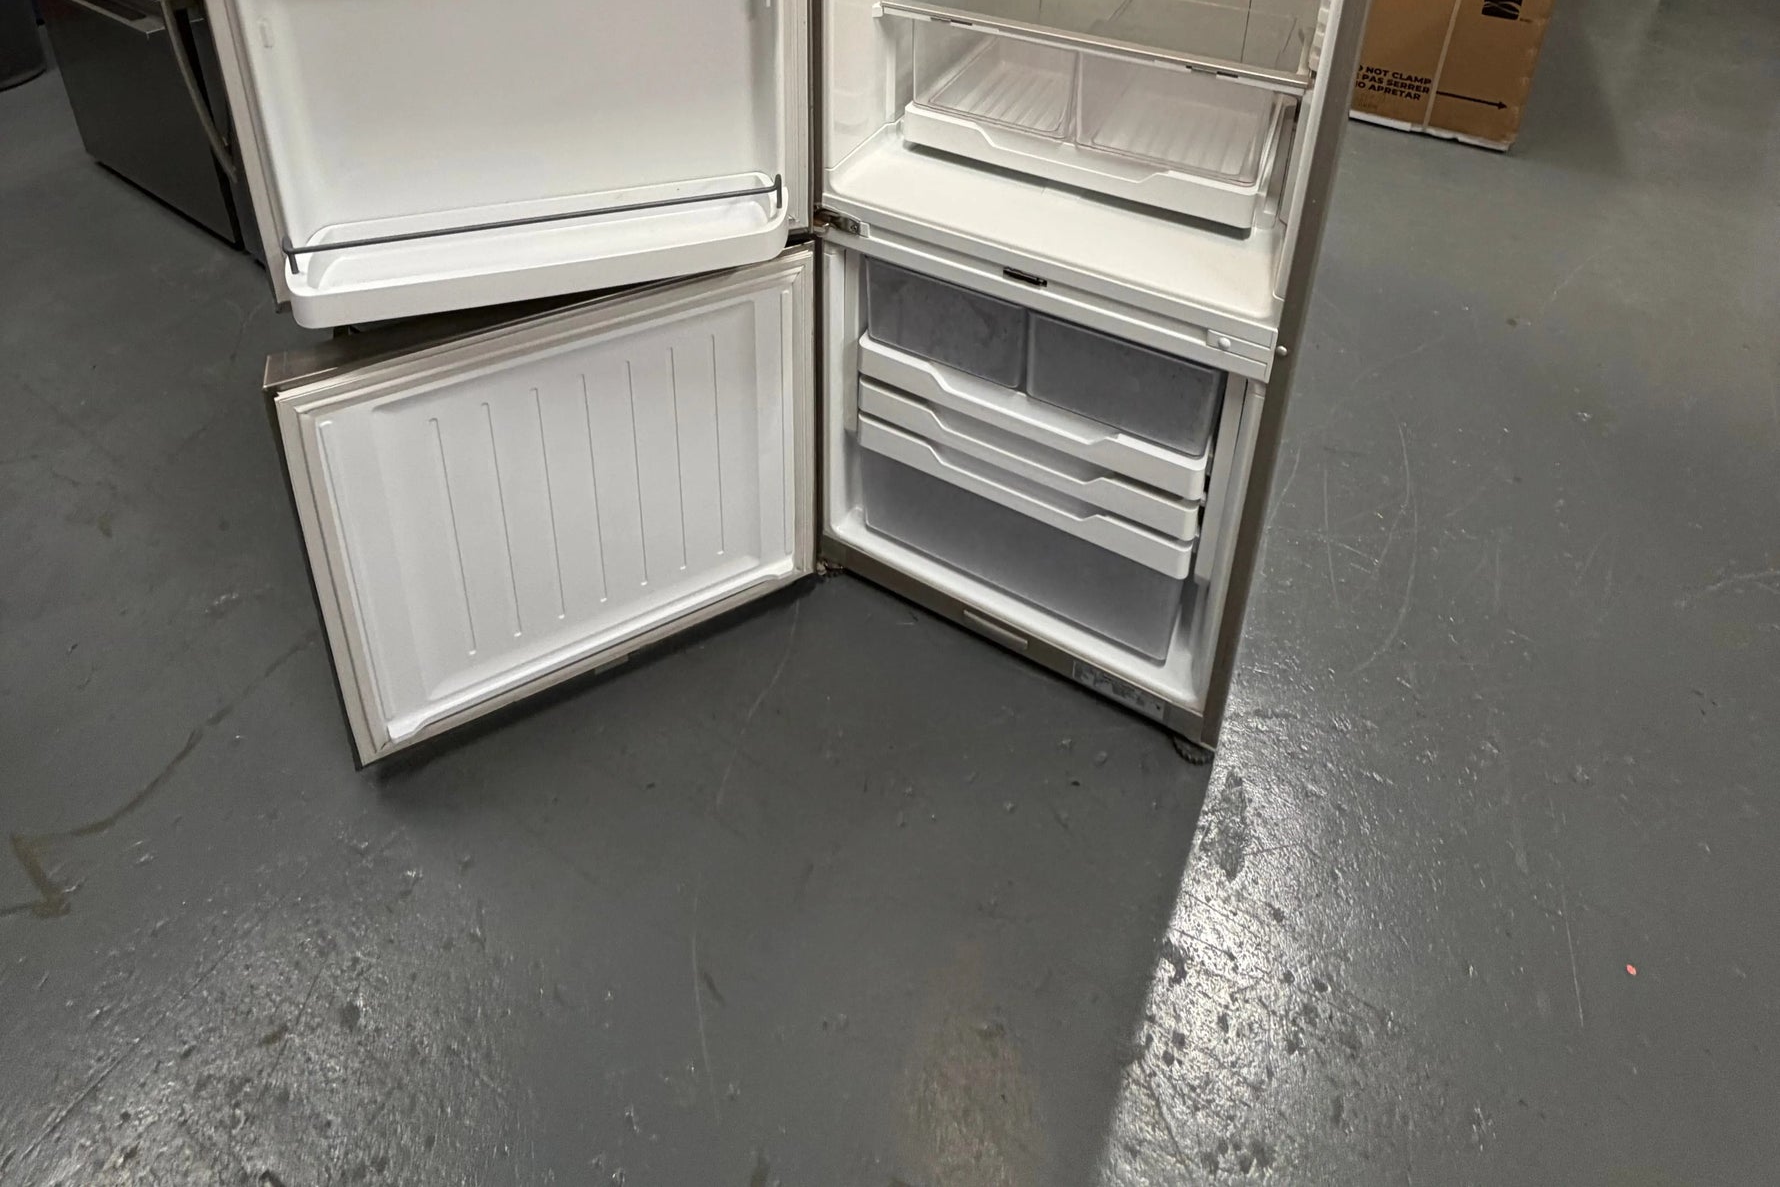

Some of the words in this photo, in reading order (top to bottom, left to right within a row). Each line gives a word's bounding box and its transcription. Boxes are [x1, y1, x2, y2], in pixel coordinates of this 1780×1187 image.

[1361, 74, 1384, 85] PAS
[1386, 78, 1430, 94] SERRER
[1366, 66, 1389, 77] NOT
[1391, 72, 1432, 85] CLAMP
[1368, 84, 1422, 101] APRETAR
